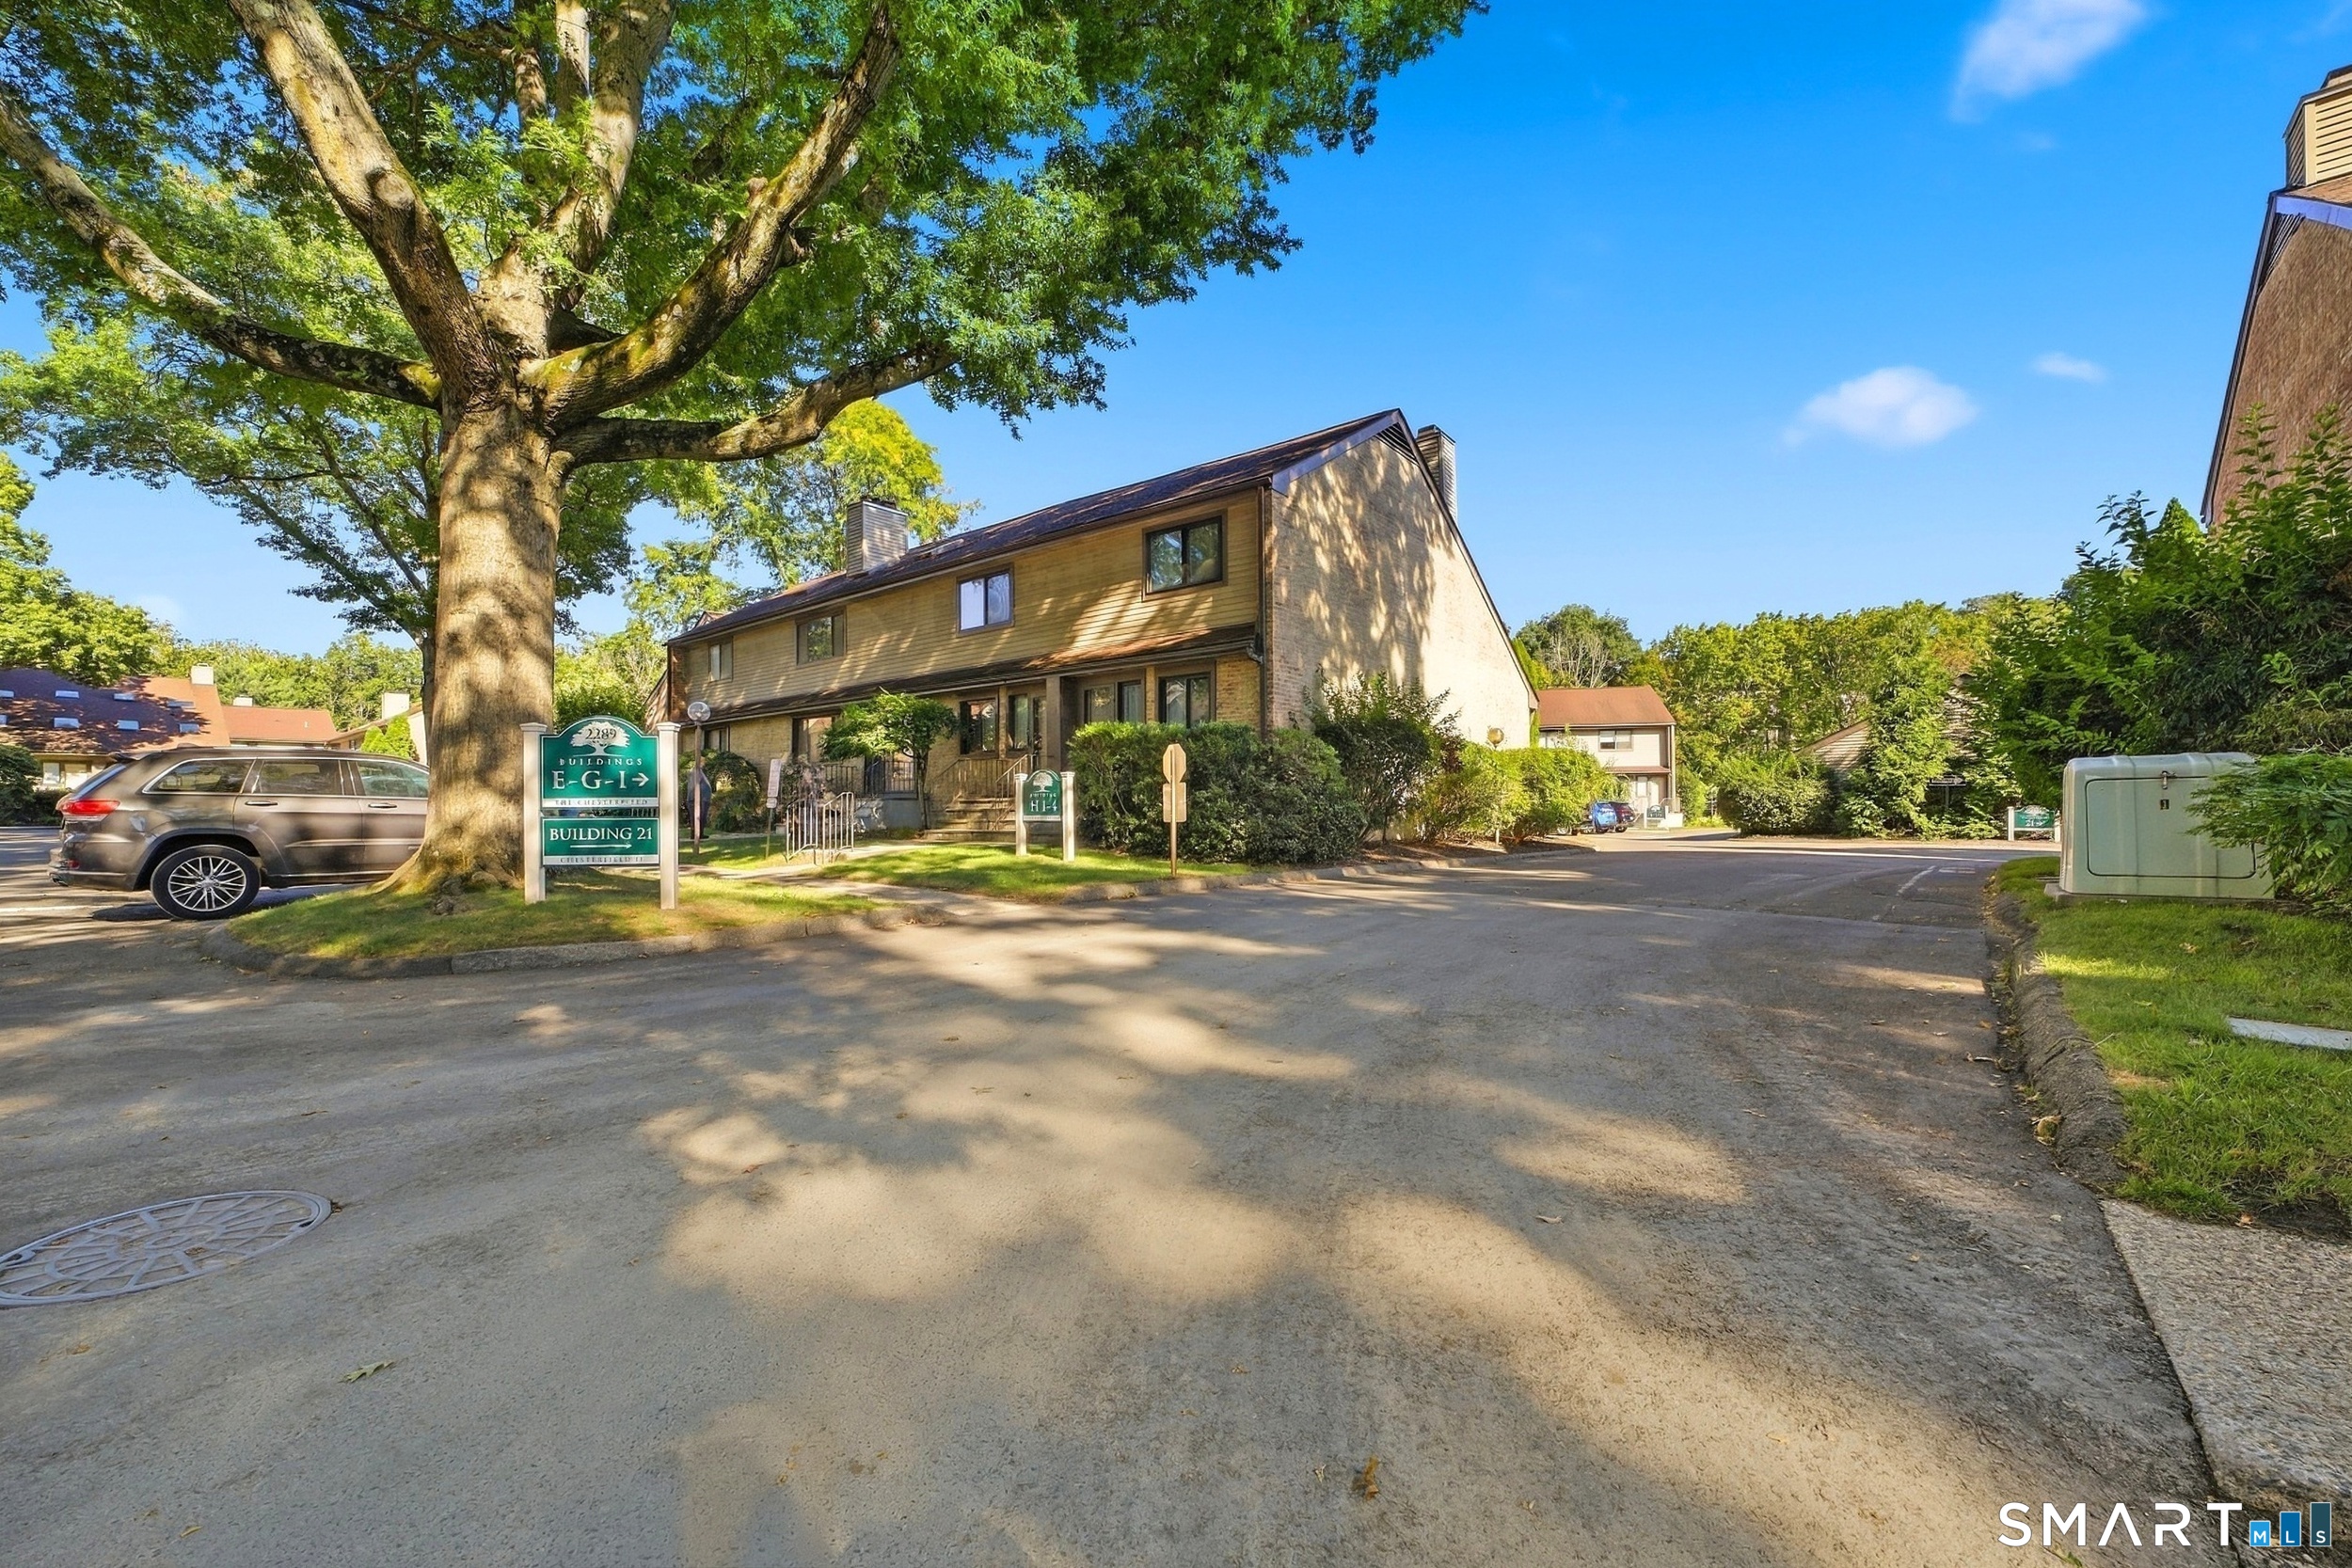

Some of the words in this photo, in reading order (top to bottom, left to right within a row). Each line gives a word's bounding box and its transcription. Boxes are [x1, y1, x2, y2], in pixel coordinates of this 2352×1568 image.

[585, 728, 617, 740] 2289
[1030, 800, 1039, 812] H
[549, 828, 632, 841] BUILDING
[637, 828, 652, 840] 21
